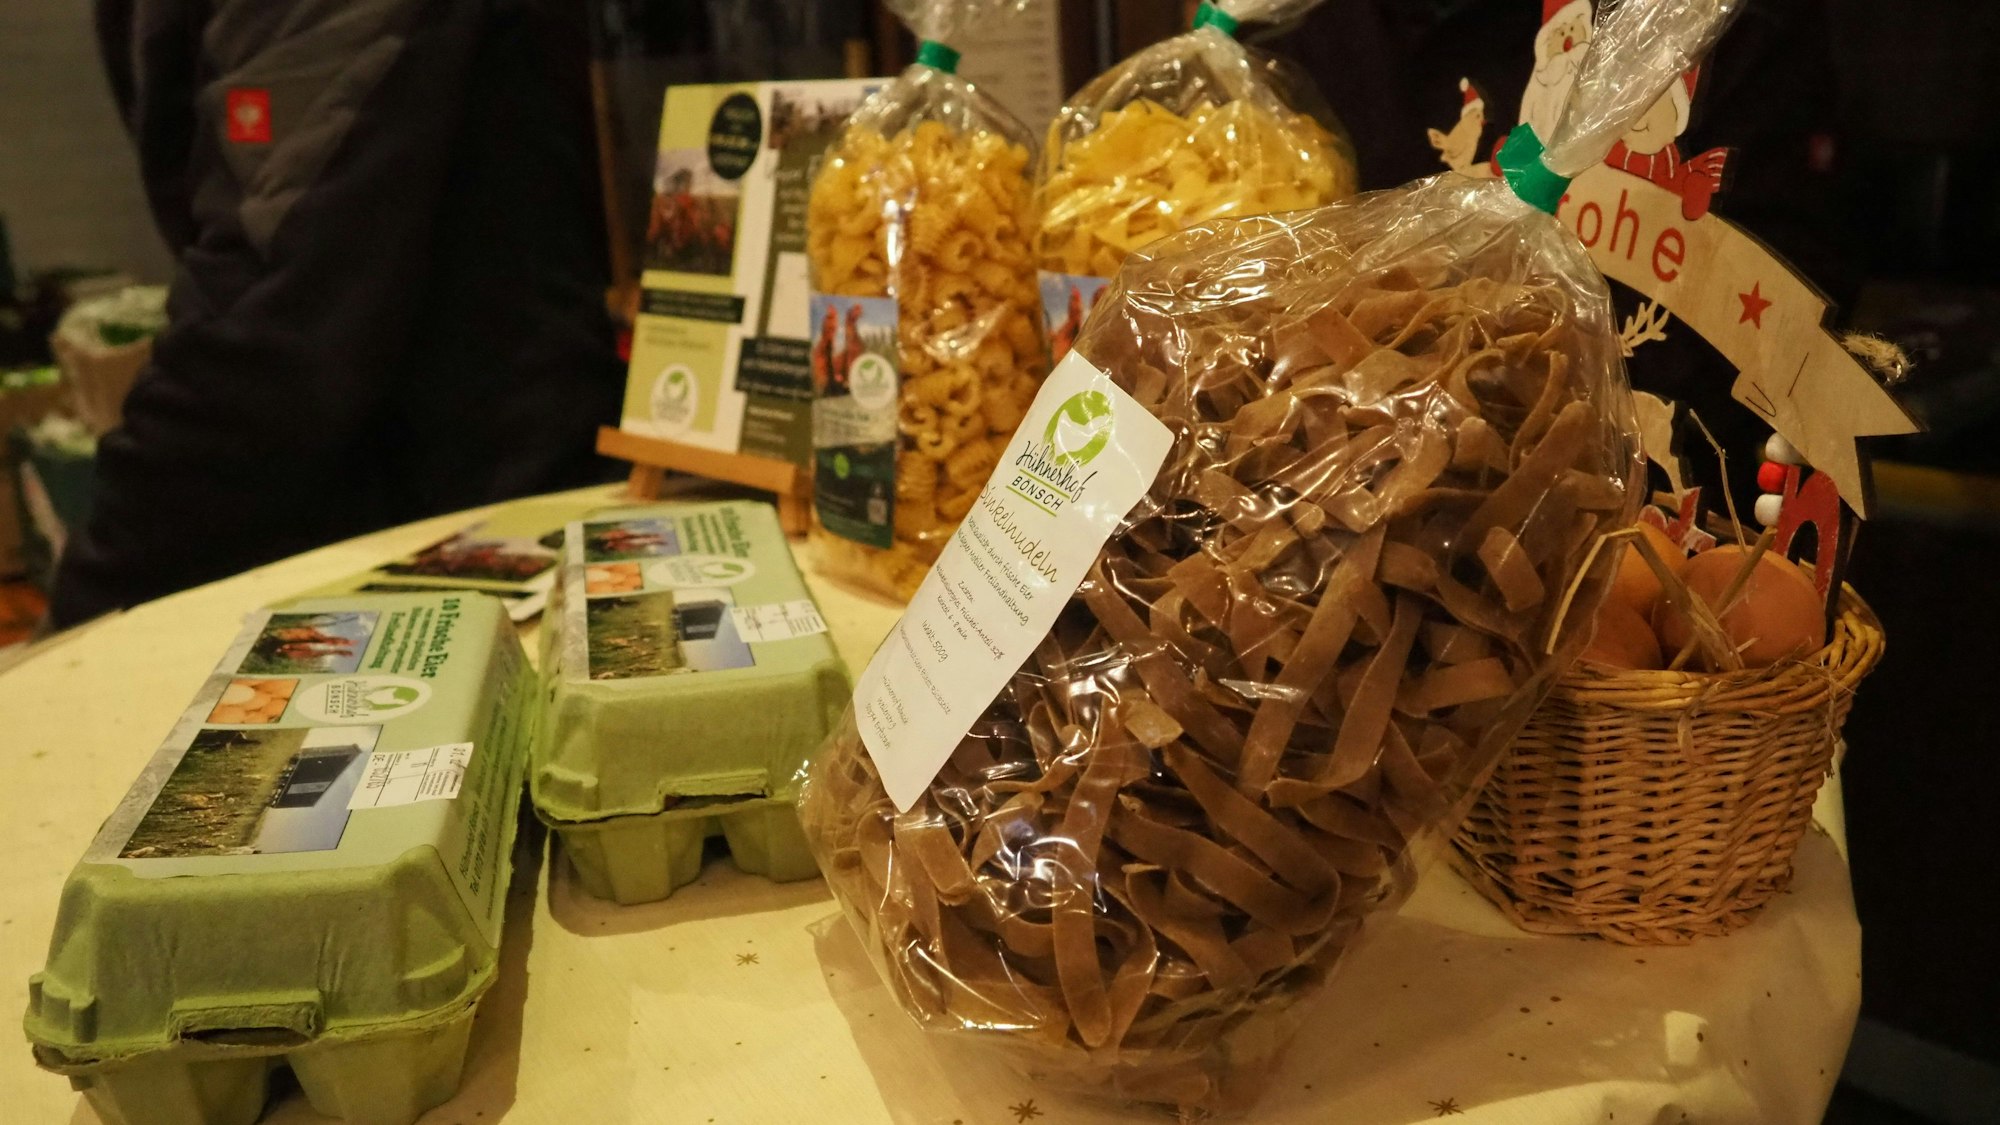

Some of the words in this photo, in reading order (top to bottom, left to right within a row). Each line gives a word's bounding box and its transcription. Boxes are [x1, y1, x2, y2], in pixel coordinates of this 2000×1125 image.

[1016, 441, 1098, 503] Hühnerhof
[1013, 476, 1063, 510] BÖNSCH
[987, 548, 1003, 566] durch
[1000, 563, 1020, 587] frische
[1020, 584, 1033, 600] Eier
[442, 599, 460, 610] 10
[984, 569, 1028, 626] Freilandhaltung
[430, 612, 460, 655] Frische
[933, 641, 948, 662] 500g
[420, 653, 448, 678] Eier
